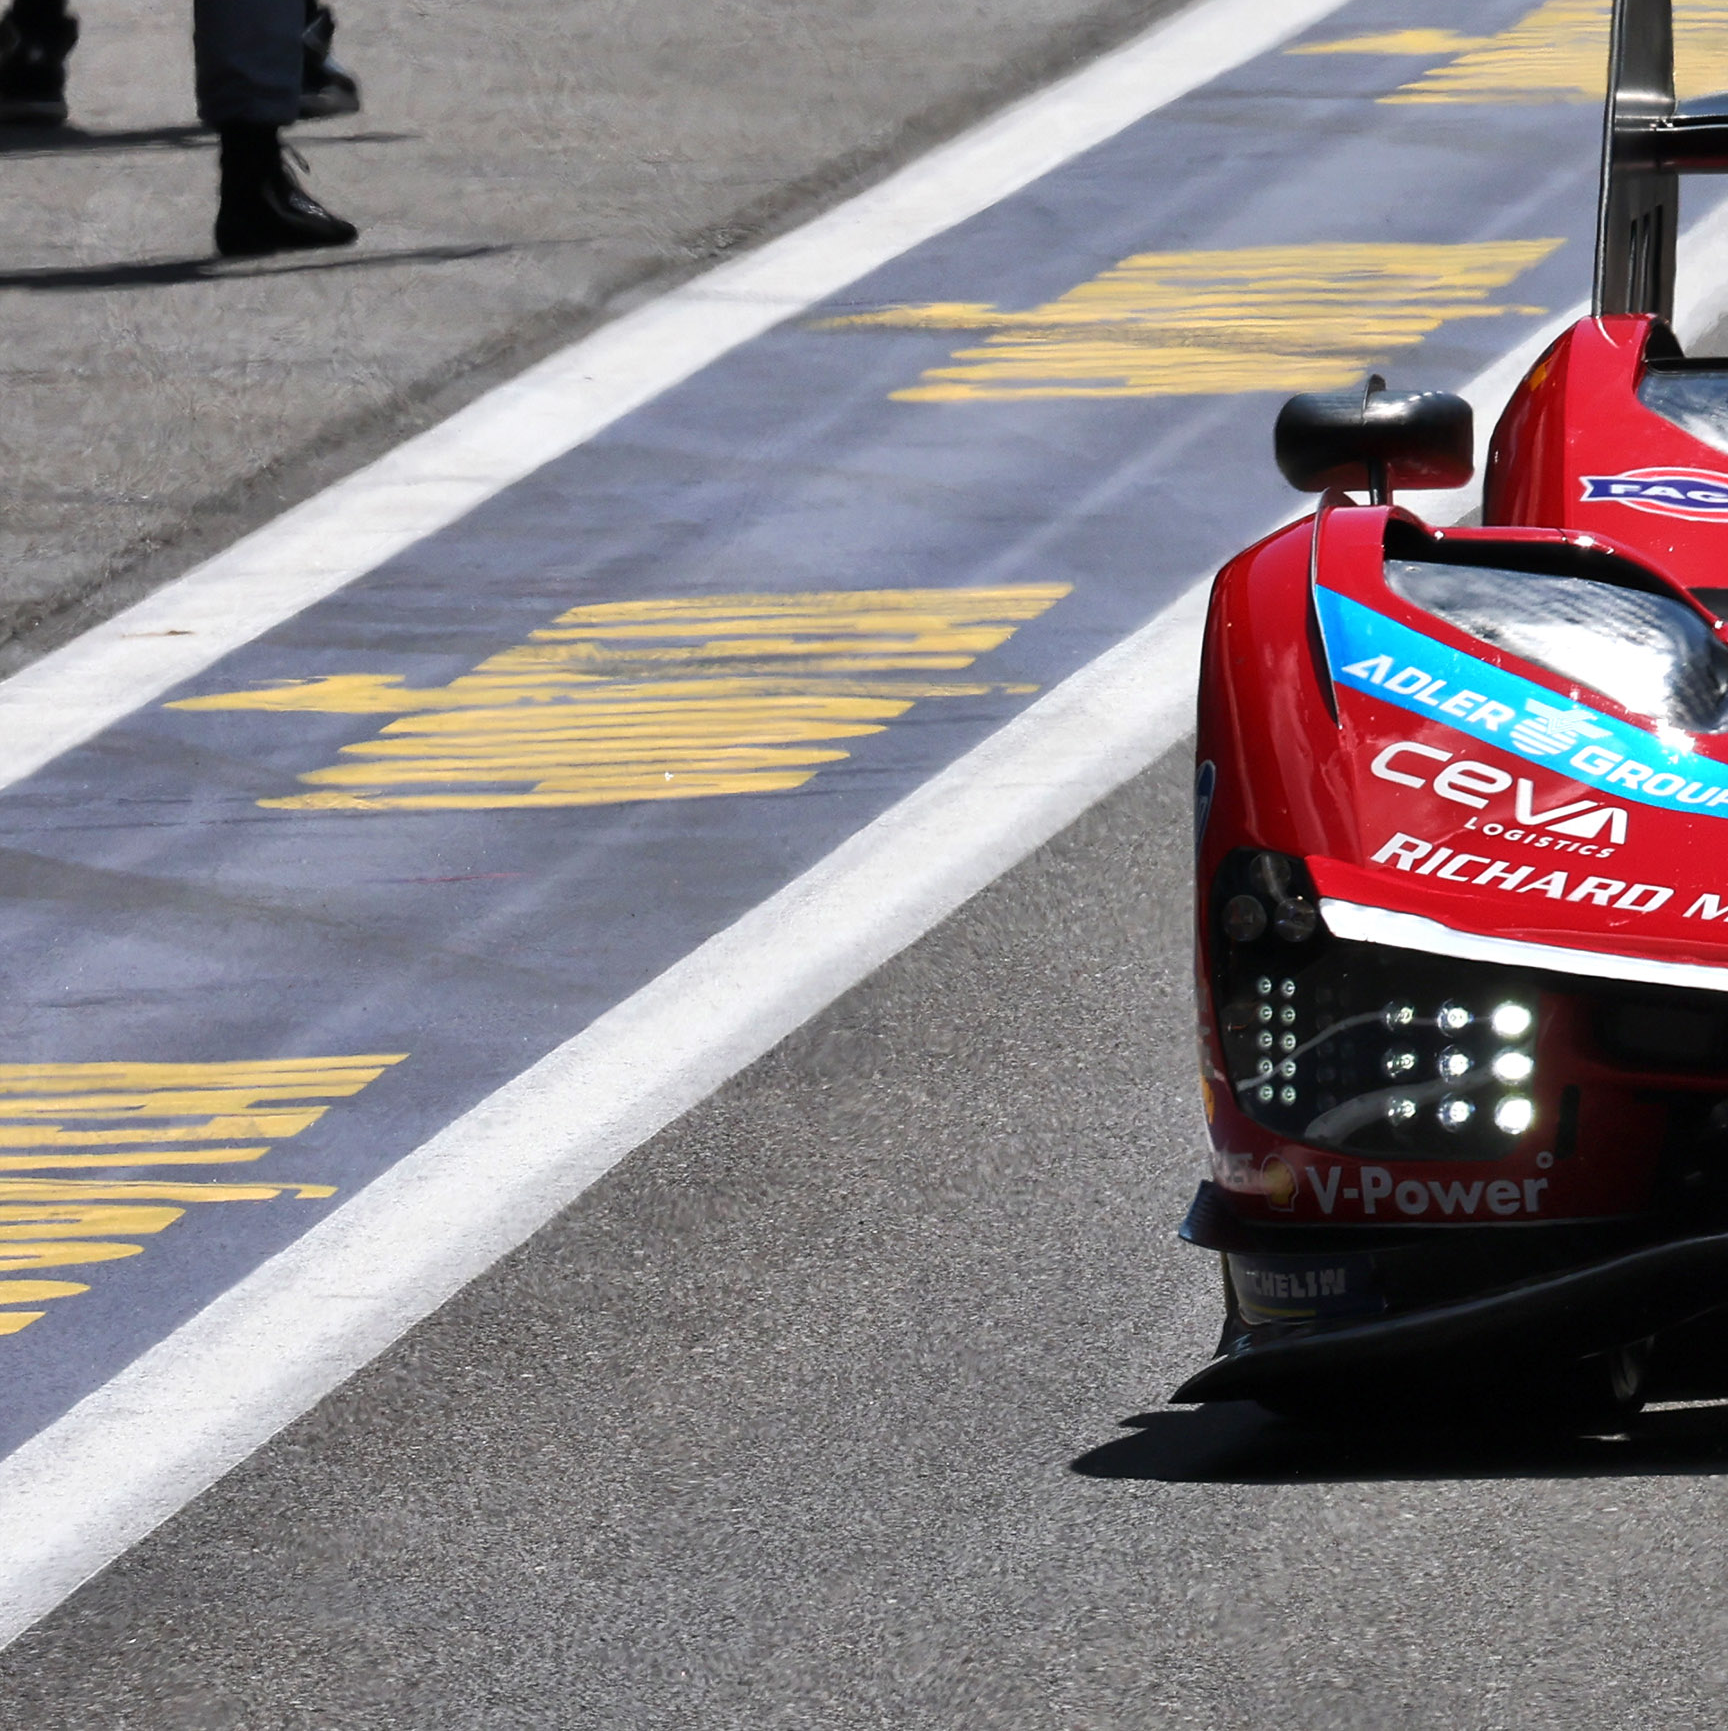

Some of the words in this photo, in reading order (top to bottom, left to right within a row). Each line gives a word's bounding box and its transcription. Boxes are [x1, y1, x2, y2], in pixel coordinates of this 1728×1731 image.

[1340, 653, 1505, 735] ADLER
[1463, 815, 1617, 861] LOGISTICS
[1370, 831, 1676, 916] RICHARD
[1304, 1165, 1549, 1215] V-Power
